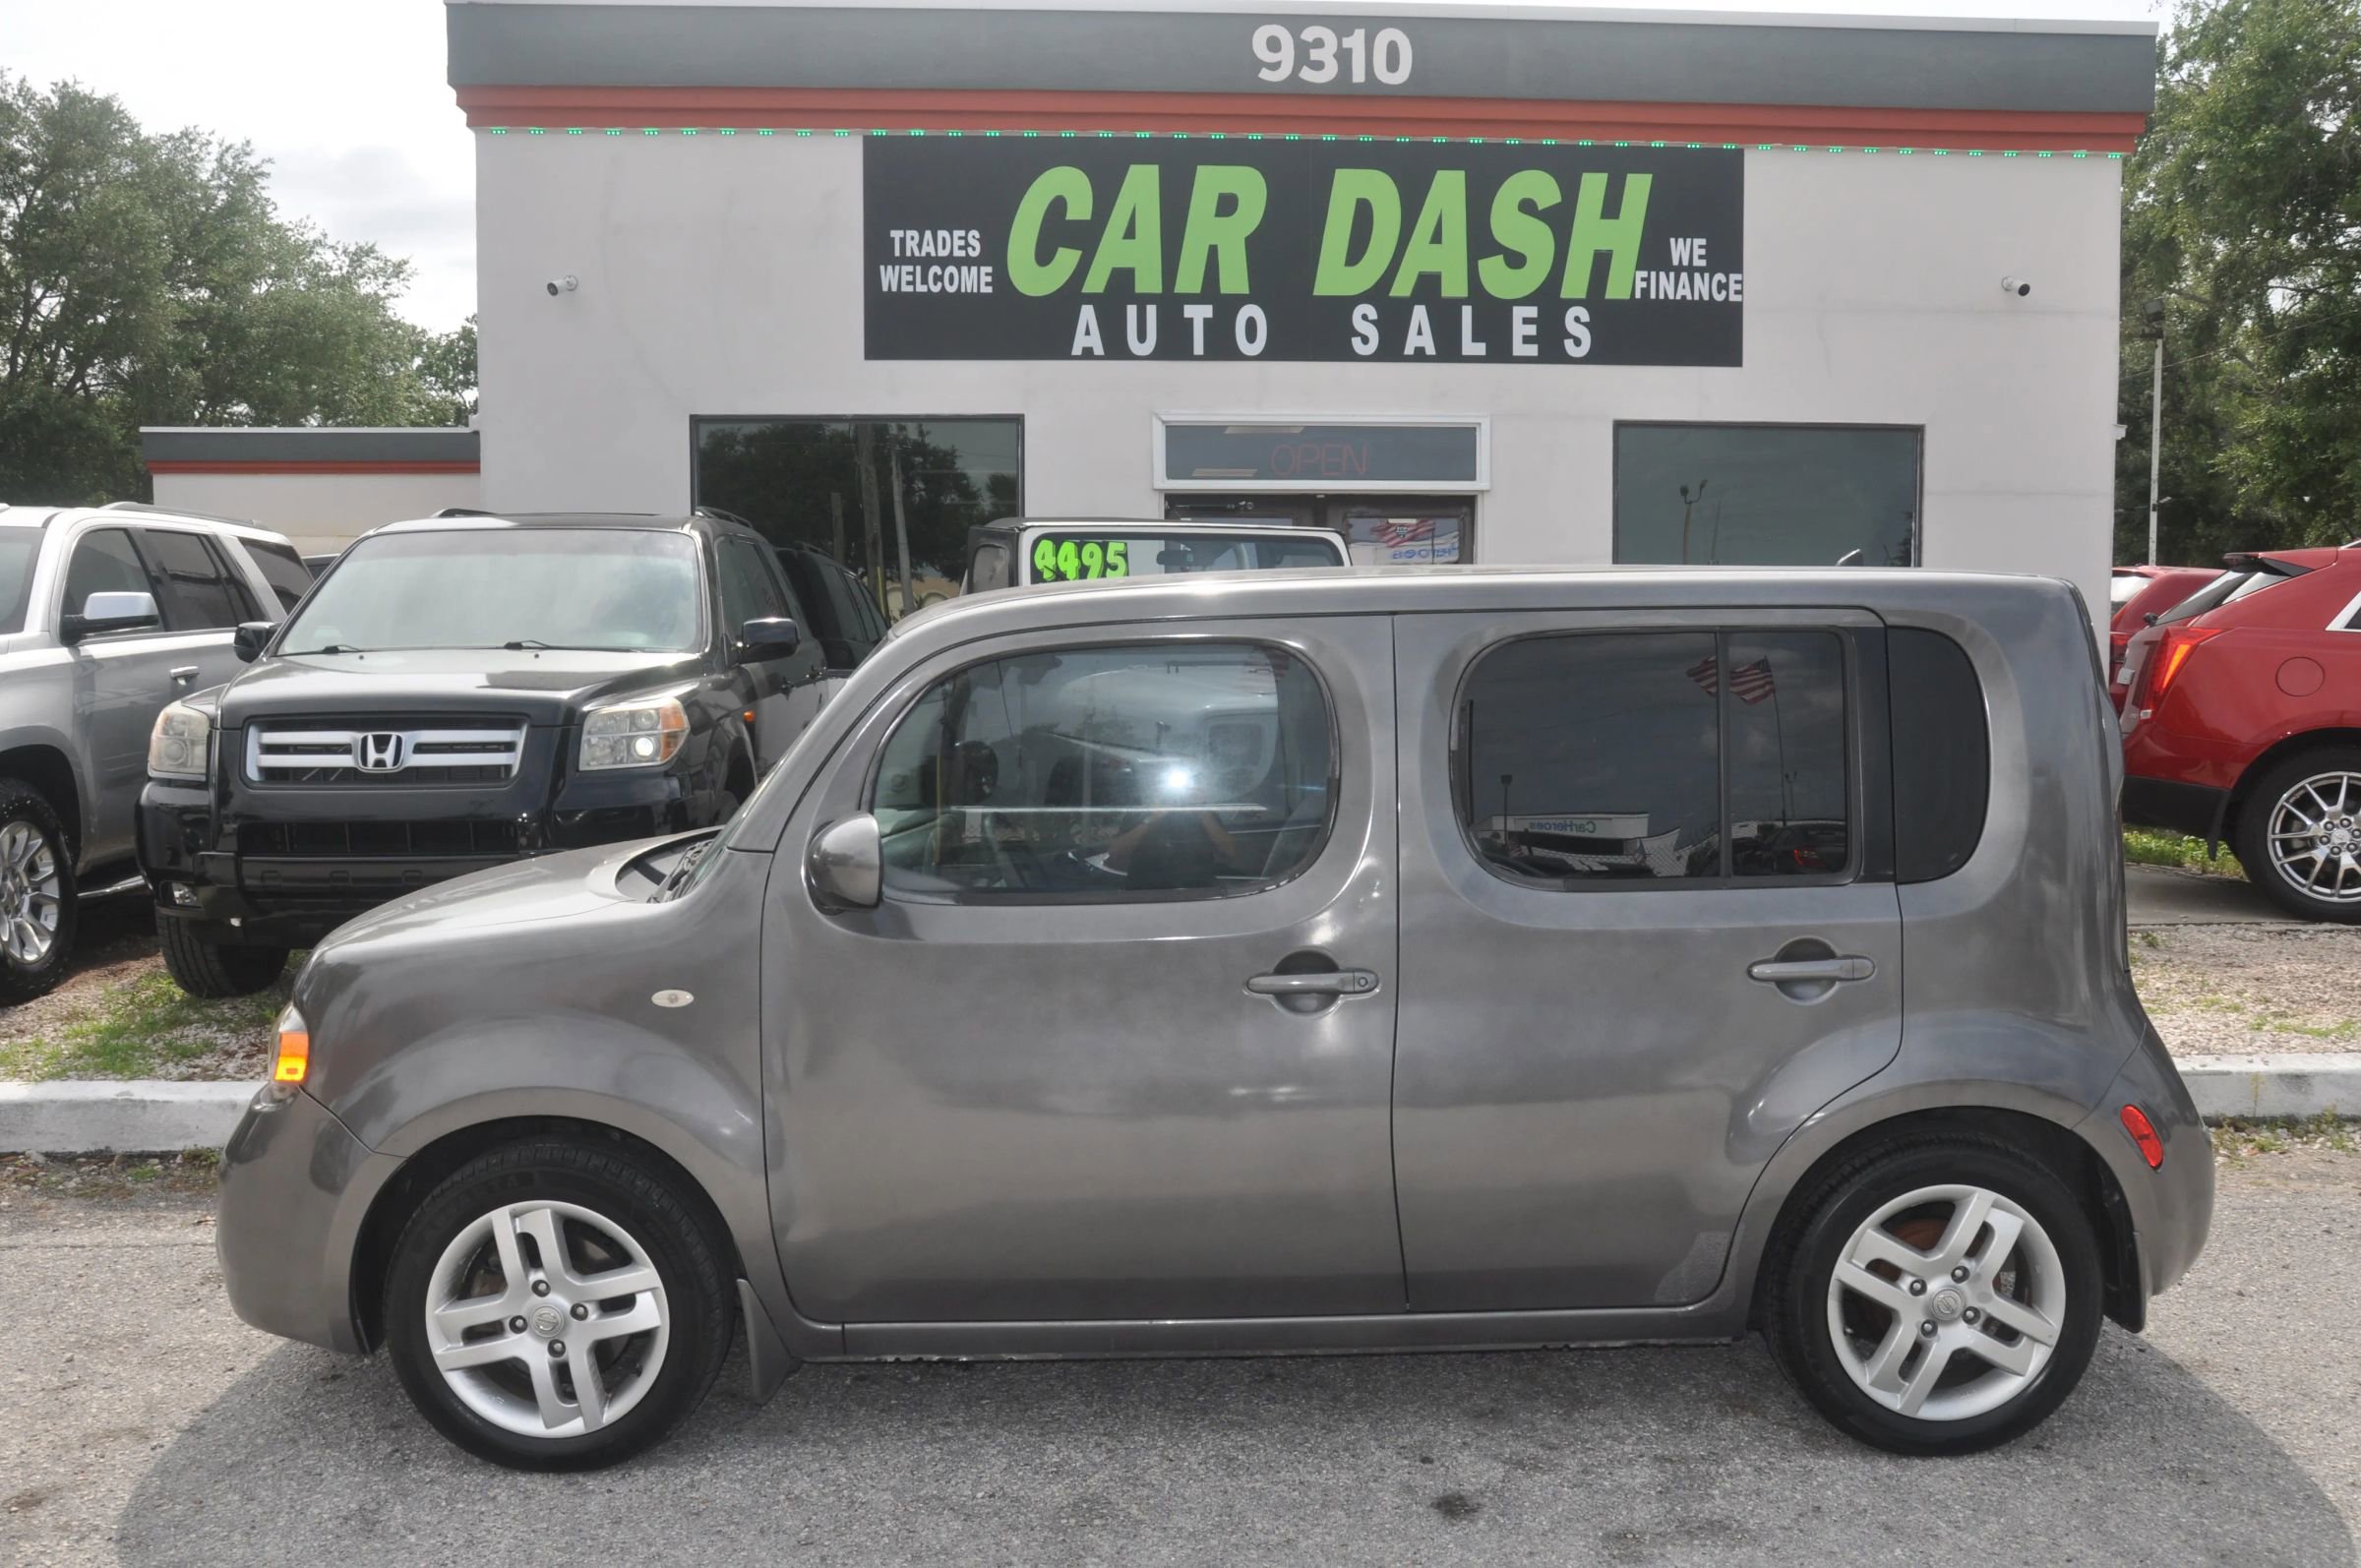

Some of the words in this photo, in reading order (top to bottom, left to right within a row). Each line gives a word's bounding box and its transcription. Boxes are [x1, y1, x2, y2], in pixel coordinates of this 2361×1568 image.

[1252, 24, 1413, 86] 9310
[889, 229, 981, 258] TRADES
[1006, 163, 1268, 297] CAR
[1313, 168, 1654, 300] DASH
[1669, 237, 1707, 267] WE
[879, 265, 994, 293] WELCOME
[1635, 271, 1743, 302] FINANCE
[1070, 303, 1268, 356] AUTO
[1351, 303, 1592, 358] SALES
[1271, 443, 1368, 476] OPEN
[1033, 538, 1128, 581] 4495
